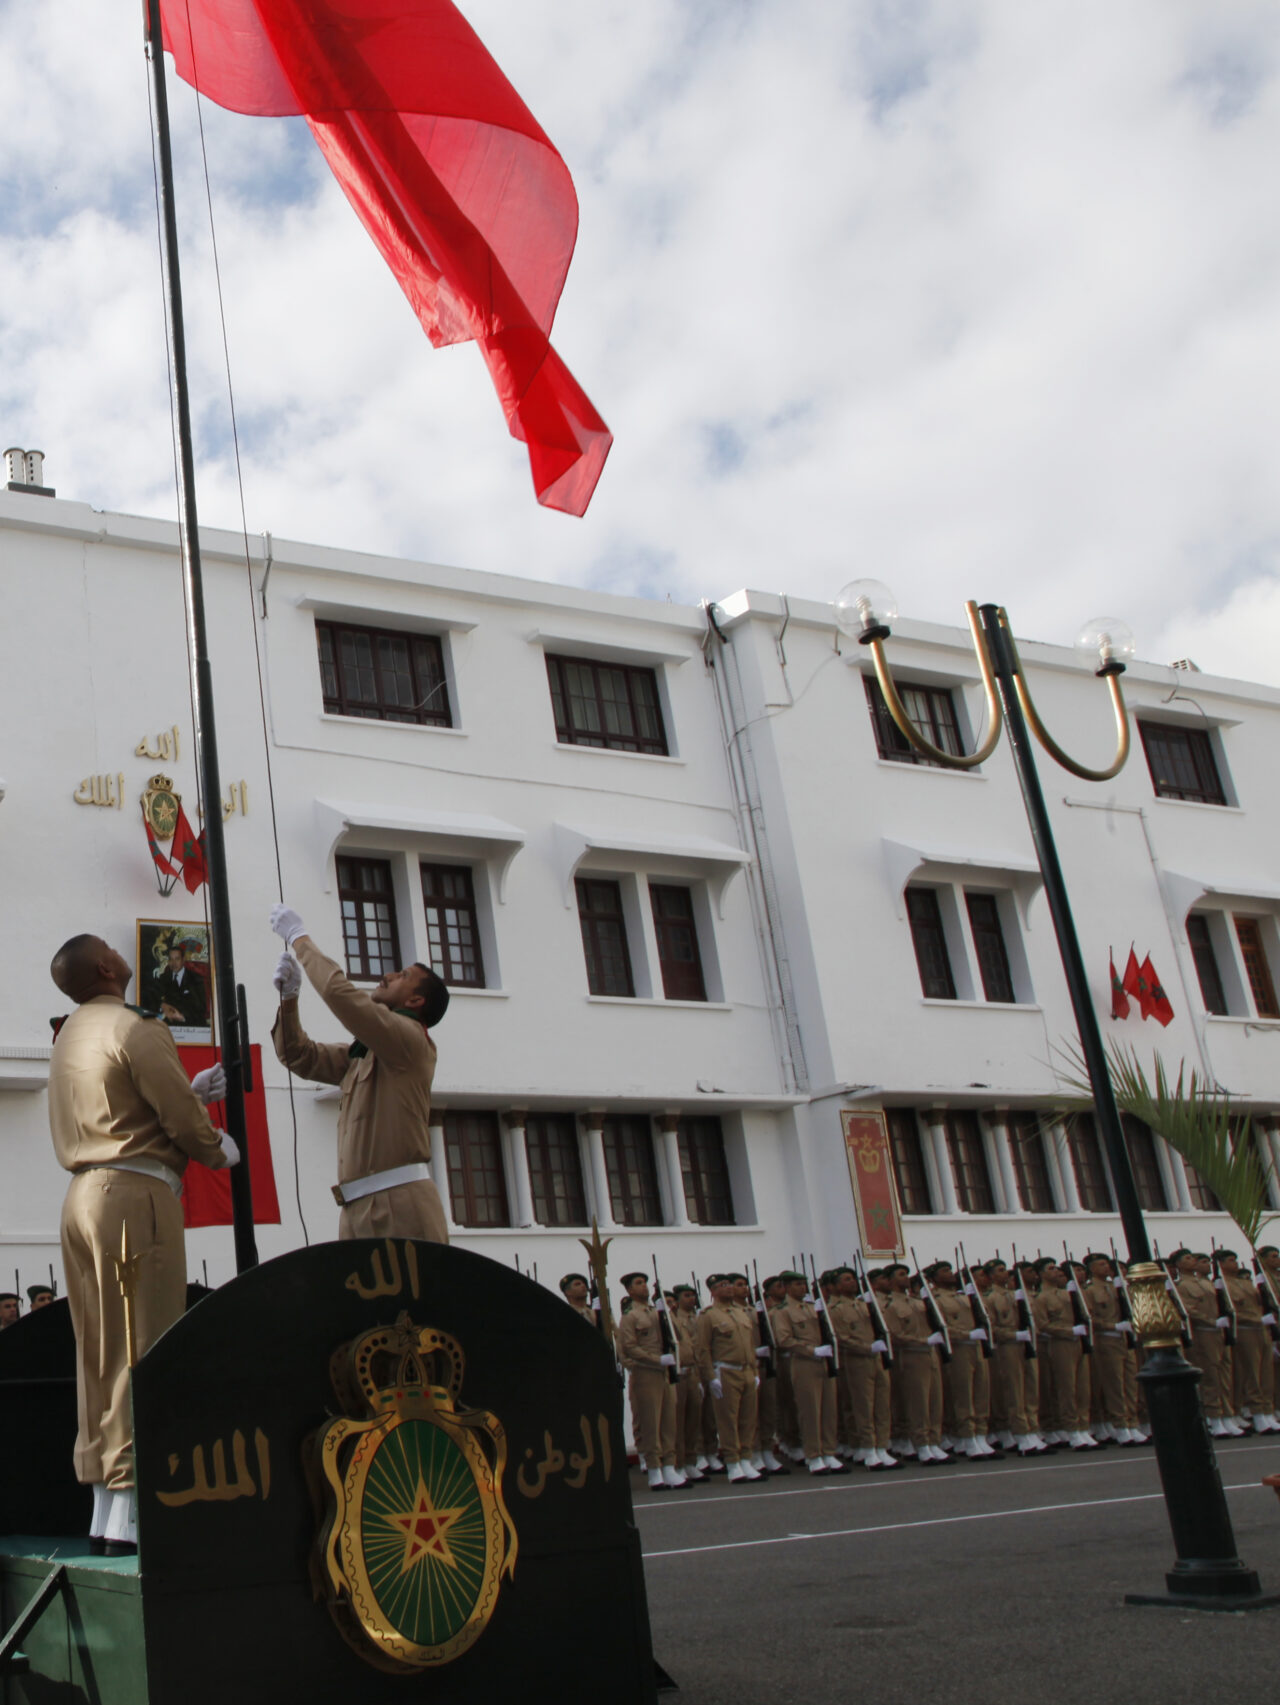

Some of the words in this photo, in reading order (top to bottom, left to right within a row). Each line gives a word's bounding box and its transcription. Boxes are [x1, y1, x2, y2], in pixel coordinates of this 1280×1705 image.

[135, 725, 179, 762] الله
[74, 772, 124, 810] الملك
[345, 1238, 419, 1300] الله
[156, 1428, 271, 1507] الملك
[517, 1412, 612, 1499] الوطن
